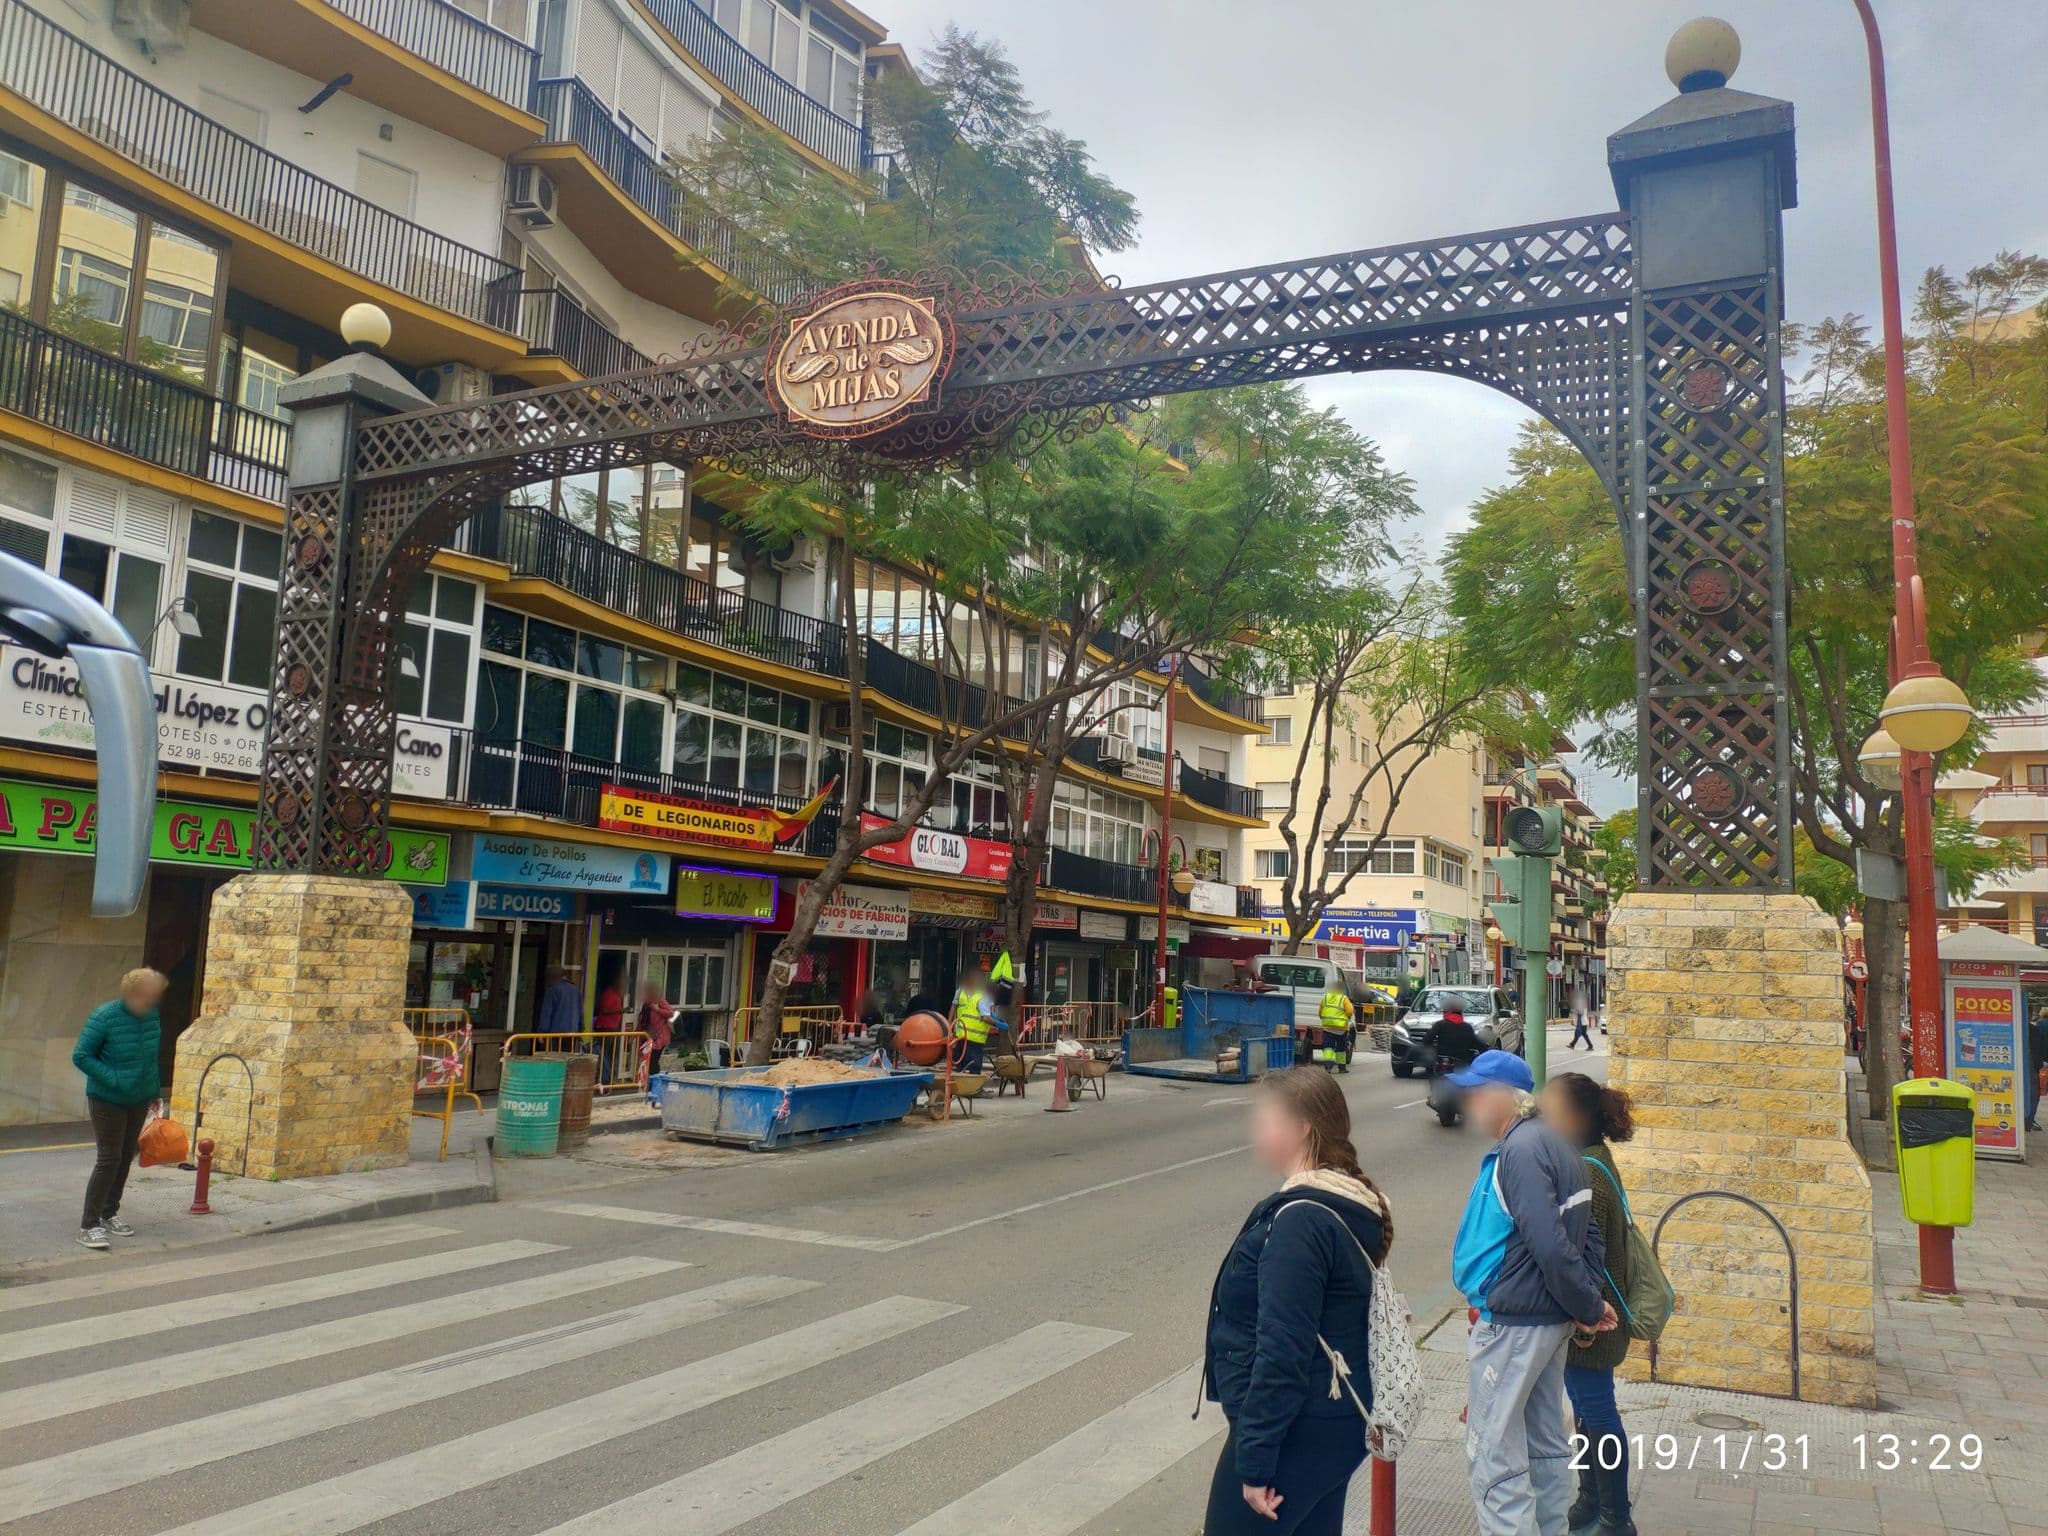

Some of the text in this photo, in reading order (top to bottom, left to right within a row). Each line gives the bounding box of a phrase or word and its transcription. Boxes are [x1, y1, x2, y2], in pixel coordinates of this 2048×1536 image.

[800, 310, 918, 355] AVENIDA
[845, 347, 869, 373] de
[811, 369, 901, 411] MIJAS
[174, 688, 240, 728] López
[397, 729, 443, 759] Cano
[159, 724, 218, 746] ÓTESIS
[167, 745, 183, 757] 52
[186, 747, 201, 760] 98
[213, 751, 235, 766] 952
[238, 755, 253, 768] 66
[634, 791, 748, 818] HERMANDAD
[623, 803, 756, 835] DE LEGIONARIOS
[630, 822, 750, 848] DE FUENGIROLA
[917, 833, 961, 859] GLOBAL
[483, 839, 587, 862] Asador De Pollos
[519, 860, 624, 886] El Flaco Argentino
[477, 892, 498, 910] DE
[501, 893, 562, 914] POLLOS
[862, 901, 907, 913] Zapato
[1040, 904, 1061, 920] UÑAS
[1367, 910, 1398, 918] TELEFONÍA
[820, 906, 907, 925] CIOS DE FABRICA
[1347, 925, 1390, 940] activa
[976, 938, 1000, 952] UÑA
[1951, 962, 1987, 971] FOTOS
[1955, 997, 2012, 1012] FOTOS
[502, 1100, 549, 1111] ETRONAS
